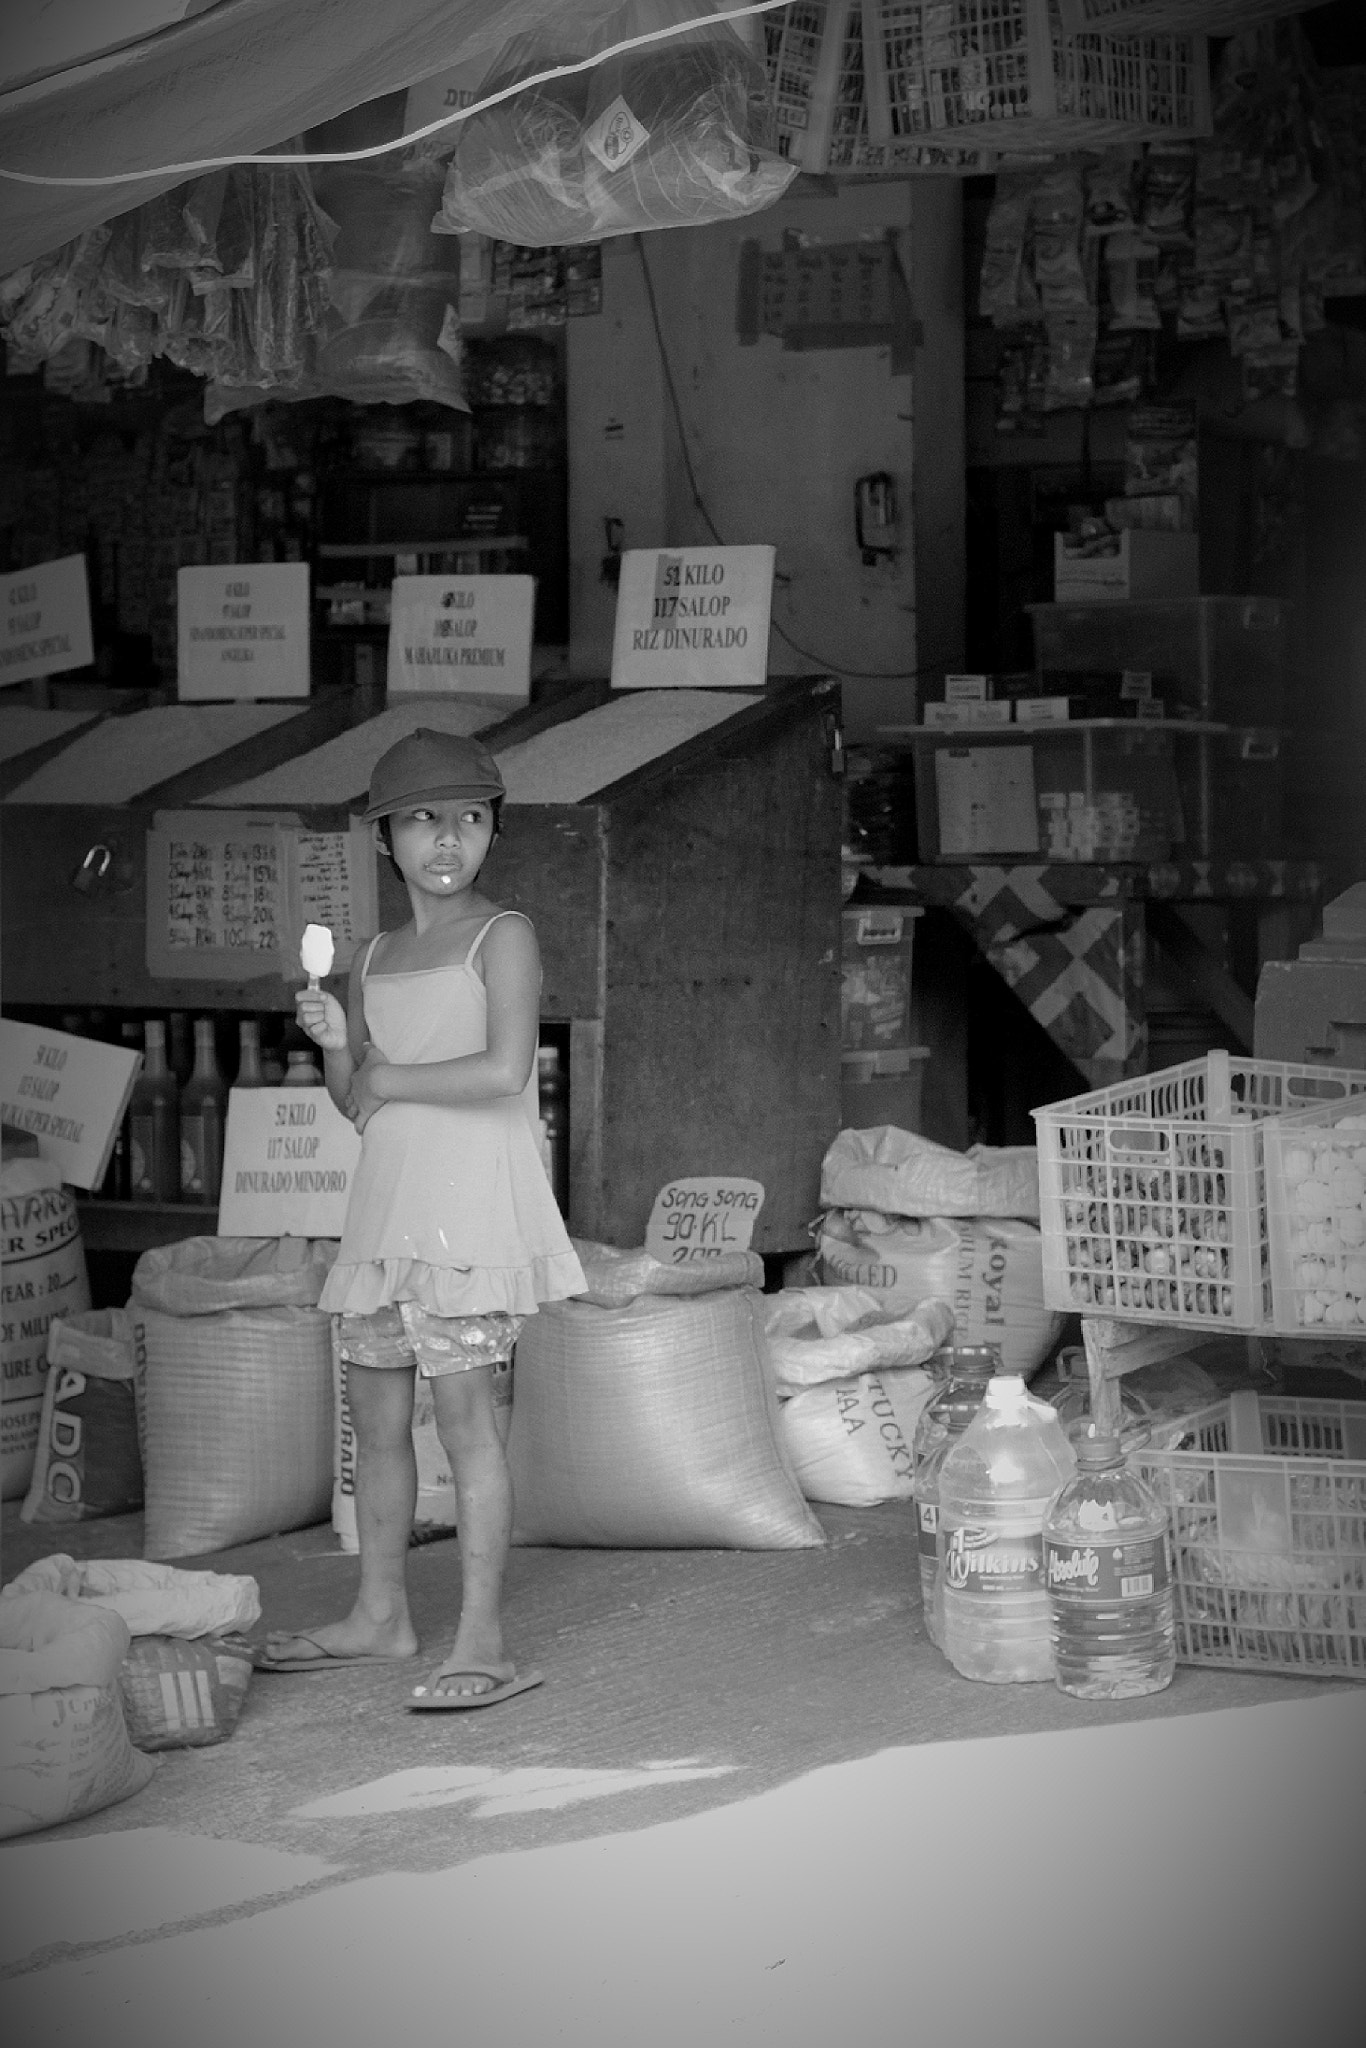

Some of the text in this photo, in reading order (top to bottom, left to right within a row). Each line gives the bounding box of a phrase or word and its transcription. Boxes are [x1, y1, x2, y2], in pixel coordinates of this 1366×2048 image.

[685, 564, 724, 586] KILO
[633, 627, 748, 650] RIZ DINURADO
[289, 1103, 317, 1126] KILO
[284, 1136, 321, 1160] SALOP
[923, 1506, 934, 1524] 4
[946, 1541, 1040, 1588] Wilkins
[1048, 1547, 1100, 1588] Absolute
